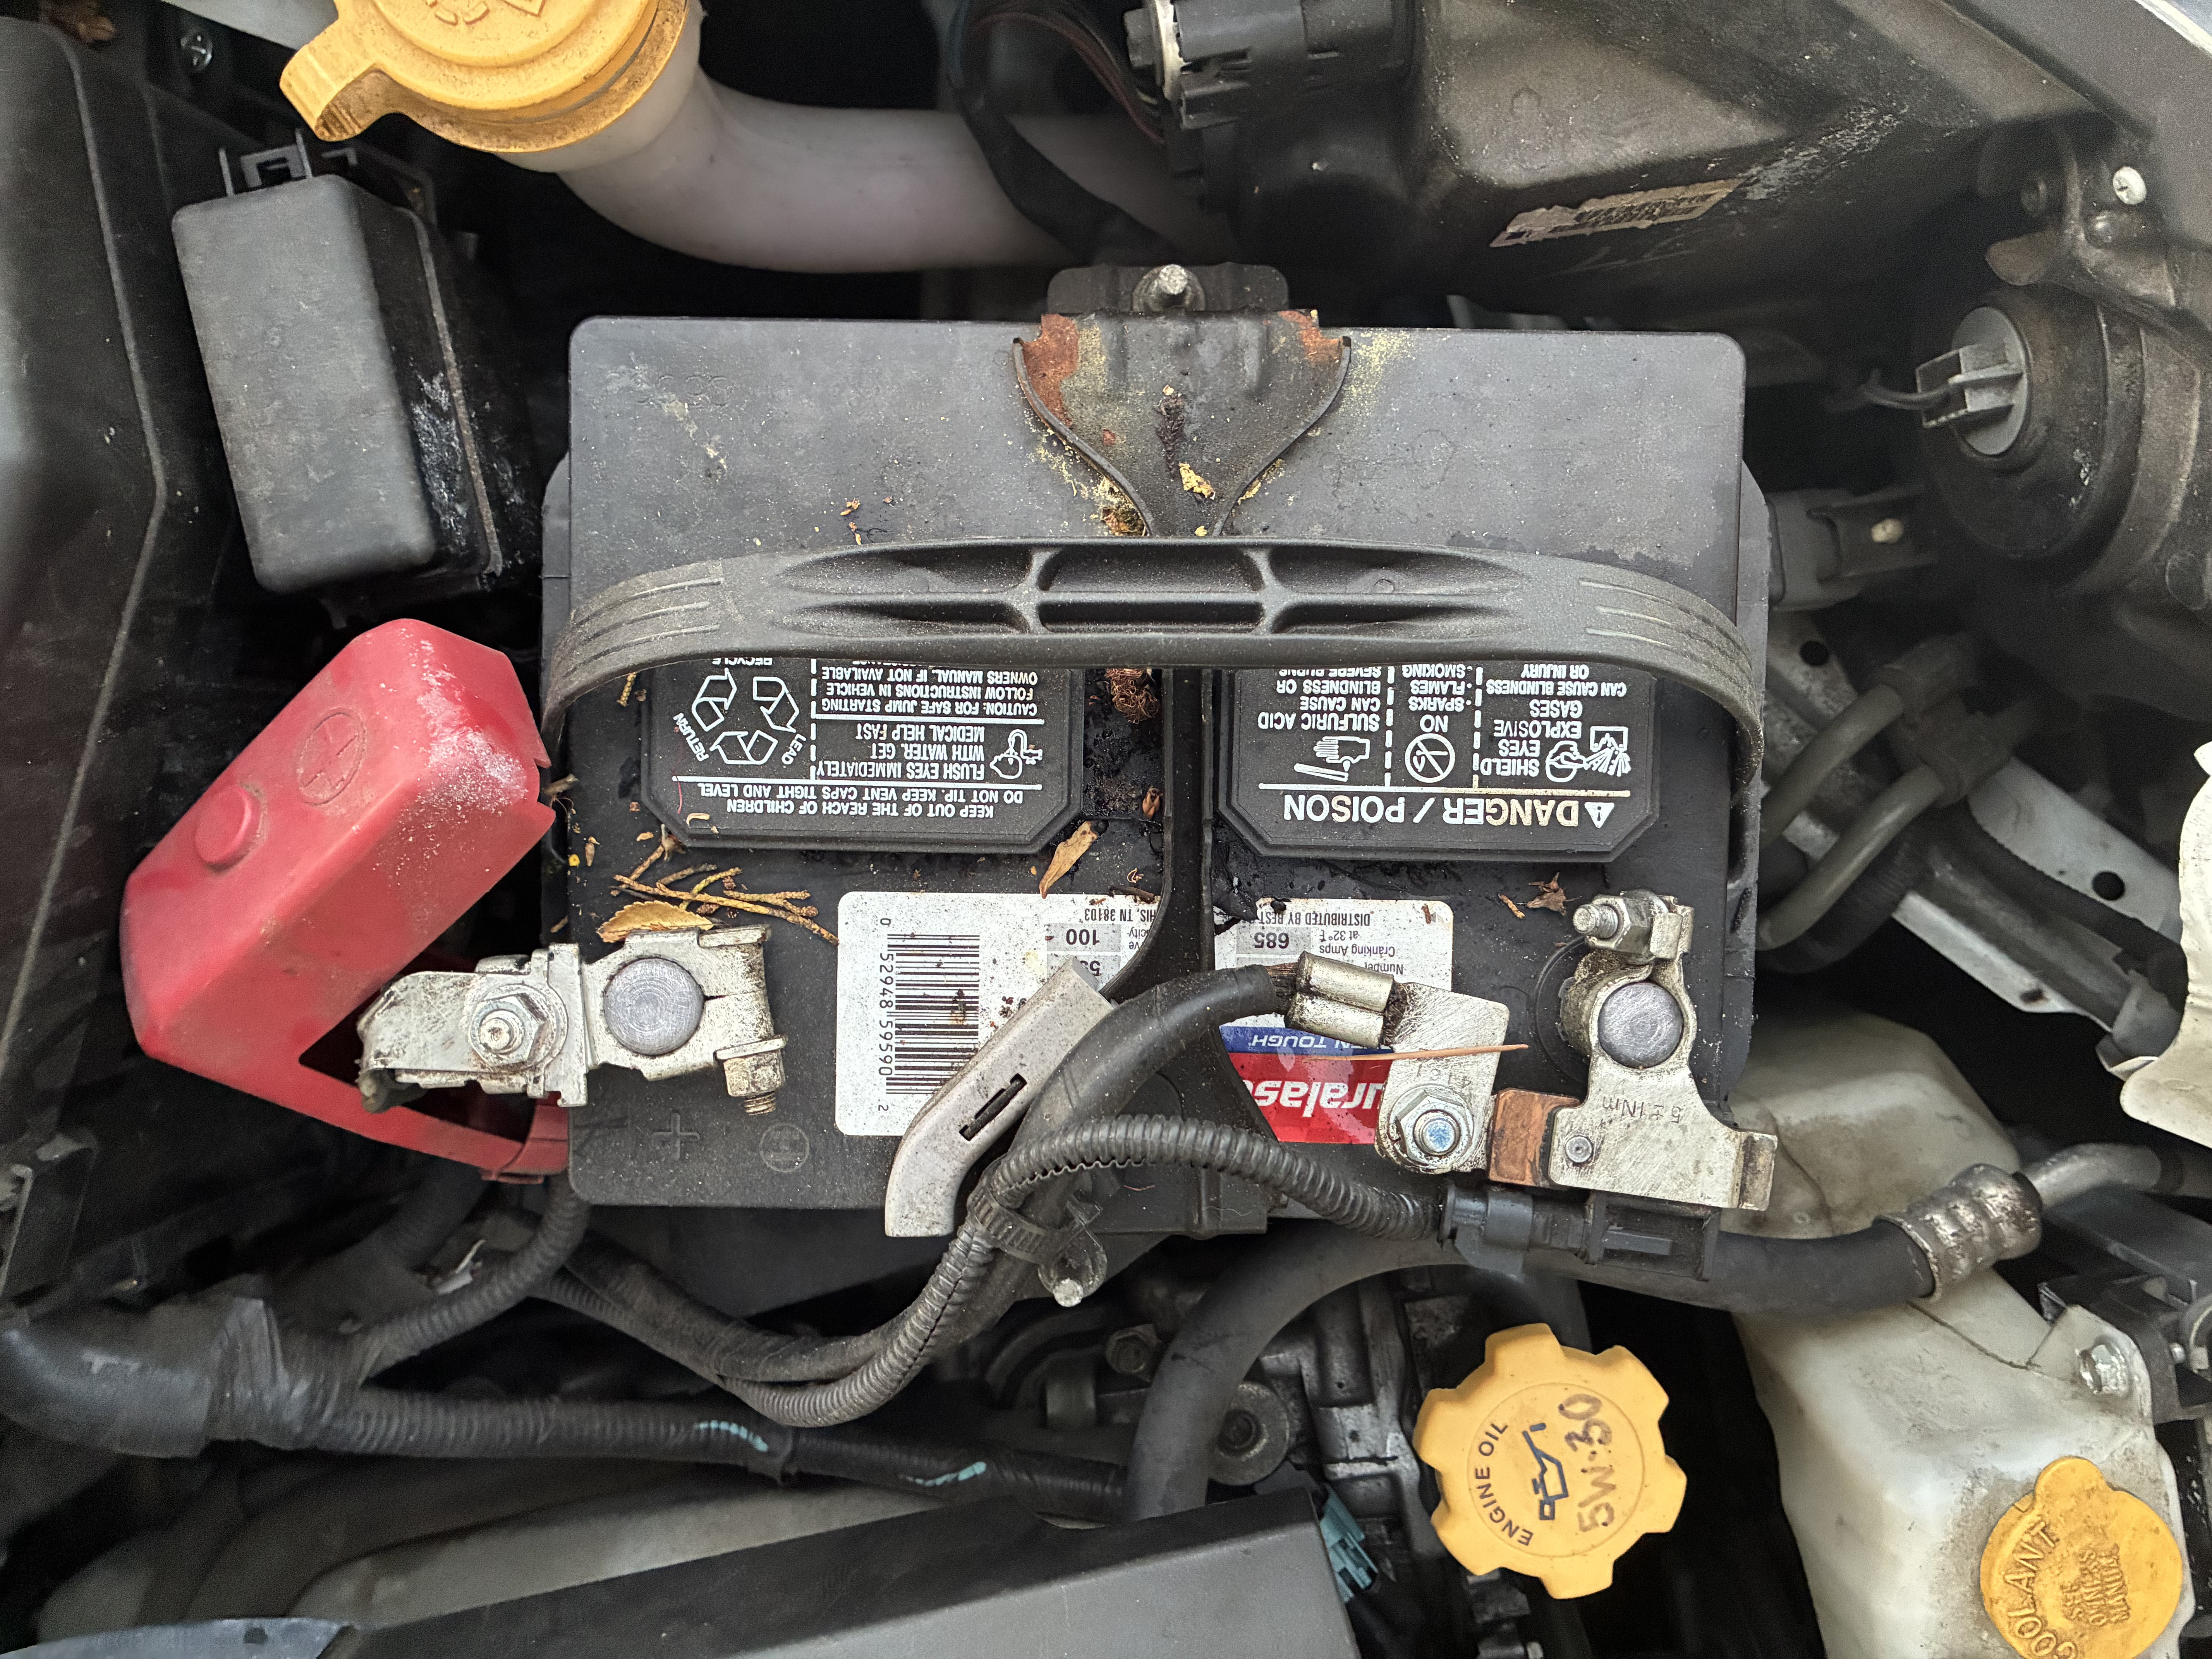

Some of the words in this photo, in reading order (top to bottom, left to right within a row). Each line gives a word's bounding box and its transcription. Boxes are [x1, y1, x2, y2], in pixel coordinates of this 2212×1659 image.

[822, 666, 883, 681] AVAILABLE
[887, 668, 912, 682] NOT
[916, 669, 927, 682] IF
[932, 670, 983, 684] MANUAL.
[987, 671, 1038, 685] OWNERS
[1402, 663, 1466, 678] SMOKING
[1521, 664, 1567, 678] INJURY
[1570, 664, 1589, 680] OR
[826, 683, 875, 696] VEHICLE
[879, 684, 891, 697] IN
[895, 684, 981, 699] INSTRUCTIONS
[984, 687, 1033, 701] FOLLOW
[1276, 679, 1297, 694] OR
[1303, 679, 1381, 695] BLINDNESS
[1410, 679, 1465, 695] FLAMES
[1486, 679, 1554, 695] BLINDNESS
[1557, 681, 1598, 697] CAUSE
[1601, 682, 1627, 697] CAN
[822, 698, 881, 713] STARTING
[885, 700, 917, 713] JUMP
[921, 700, 951, 714] SAFE
[955, 701, 979, 715] FOR
[983, 702, 1037, 716] CAUTION:
[1300, 696, 1346, 711] CAUSE
[1351, 697, 1381, 712] CAN
[1408, 696, 1465, 712] SPARKS
[1529, 699, 1583, 718] GASES
[1258, 712, 1296, 730] ACID
[1301, 713, 1380, 732] SULFURIC
[1420, 714, 1448, 732] NO
[855, 723, 887, 740] FAST
[892, 724, 925, 741] HELP
[929, 725, 985, 742] MEDICAL
[1493, 720, 1582, 739] EXPLOSIVE
[674, 713, 709, 762] RETURN
[781, 733, 806, 764] LEAD
[870, 743, 896, 760] GET
[901, 743, 948, 761] WATER.
[952, 744, 984, 761] WITH
[1498, 739, 1540, 757] EYES
[816, 760, 902, 781] IMMEDIATELY
[906, 762, 939, 779] EYES
[943, 763, 984, 780] FLUSH
[1480, 758, 1540, 777] SHIELD
[697, 783, 738, 797] LEVEL
[743, 785, 771, 798] AND
[776, 786, 817, 799] TIGHT
[821, 786, 857, 800] CAPS
[862, 787, 897, 801] VENT
[902, 788, 936, 802] KEEP
[941, 789, 966, 802] TIP.
[971, 790, 998, 803] NOT
[1003, 790, 1023, 804] DO
[727, 799, 794, 814] CHILDREN
[799, 801, 817, 814] OF
[822, 801, 867, 815] REACH
[872, 802, 899, 816] THE
[900, 803, 922, 817] OF
[927, 804, 955, 817] OUT
[960, 804, 994, 818] KEEP
[1284, 794, 1405, 823] POISON
[1413, 797, 1436, 823] /
[1443, 798, 1579, 826] DANGER
[1084, 908, 1116, 921] 38103
[1119, 909, 1132, 921] TN
[1260, 911, 1284, 925] BEST
[1288, 912, 1301, 925] BY
[1305, 912, 1370, 926] DISTRIBUTED
[1066, 929, 1100, 946] 100
[1254, 933, 1290, 948] 685
[1328, 930, 1346, 941] 32°
[1349, 931, 1359, 941] at
[1319, 943, 1348, 957] Amps
[1351, 943, 1396, 957] Cranking
[879, 953, 893, 1009] 52948
[878, 1020, 892, 1076] 59590
[1252, 1035, 1327, 1048] TOUGH
[878, 1104, 889, 1112] 2
[1479, 1422, 1508, 1457] OIL
[1475, 1466, 1534, 1546] ENGINE
